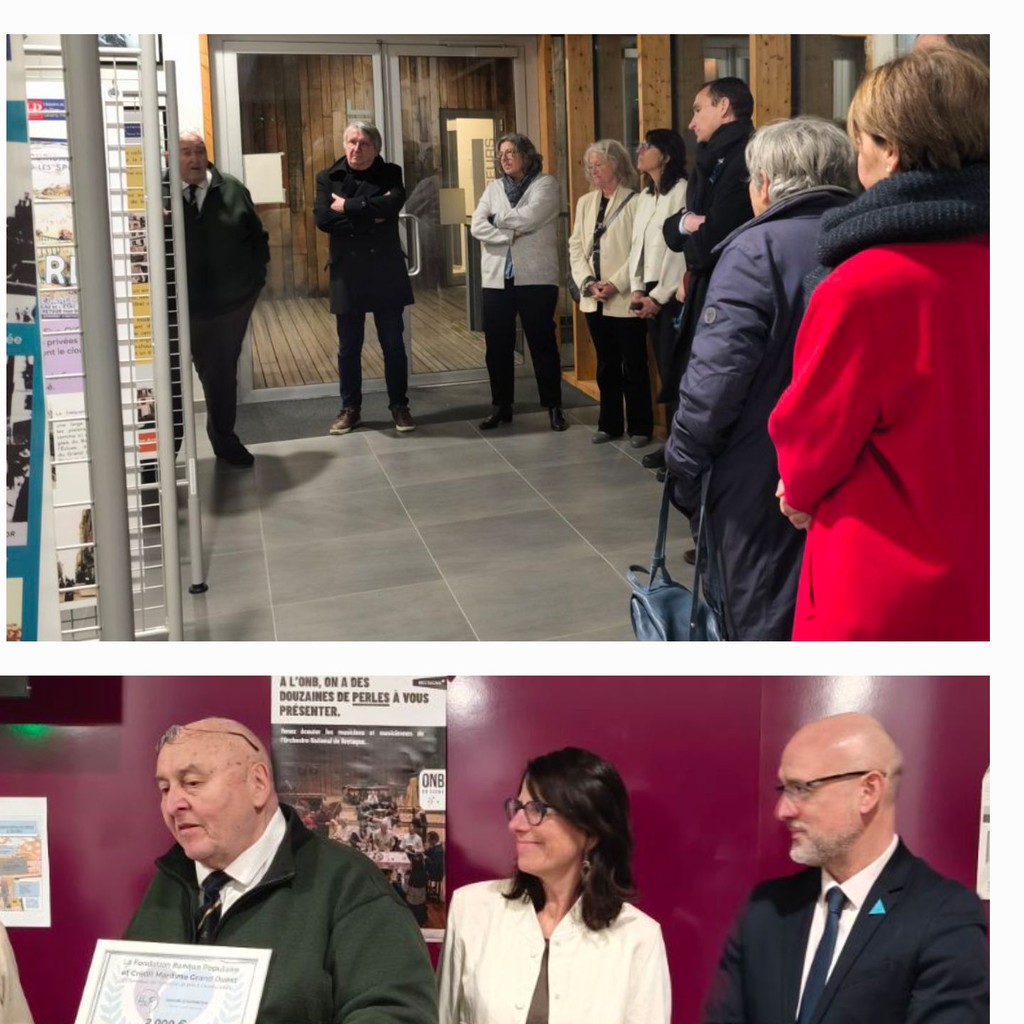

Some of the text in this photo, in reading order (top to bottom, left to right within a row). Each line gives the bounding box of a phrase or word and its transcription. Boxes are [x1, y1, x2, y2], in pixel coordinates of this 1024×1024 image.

[47, 337, 78, 346] privées
[324, 677, 338, 687] ON
[340, 677, 348, 688] A
[350, 677, 370, 688] DES
[279, 690, 429, 704] DOUZAINES DE PERLES À VOUS
[279, 704, 340, 717] PRÉSENTER.
[421, 773, 445, 788] ONB
